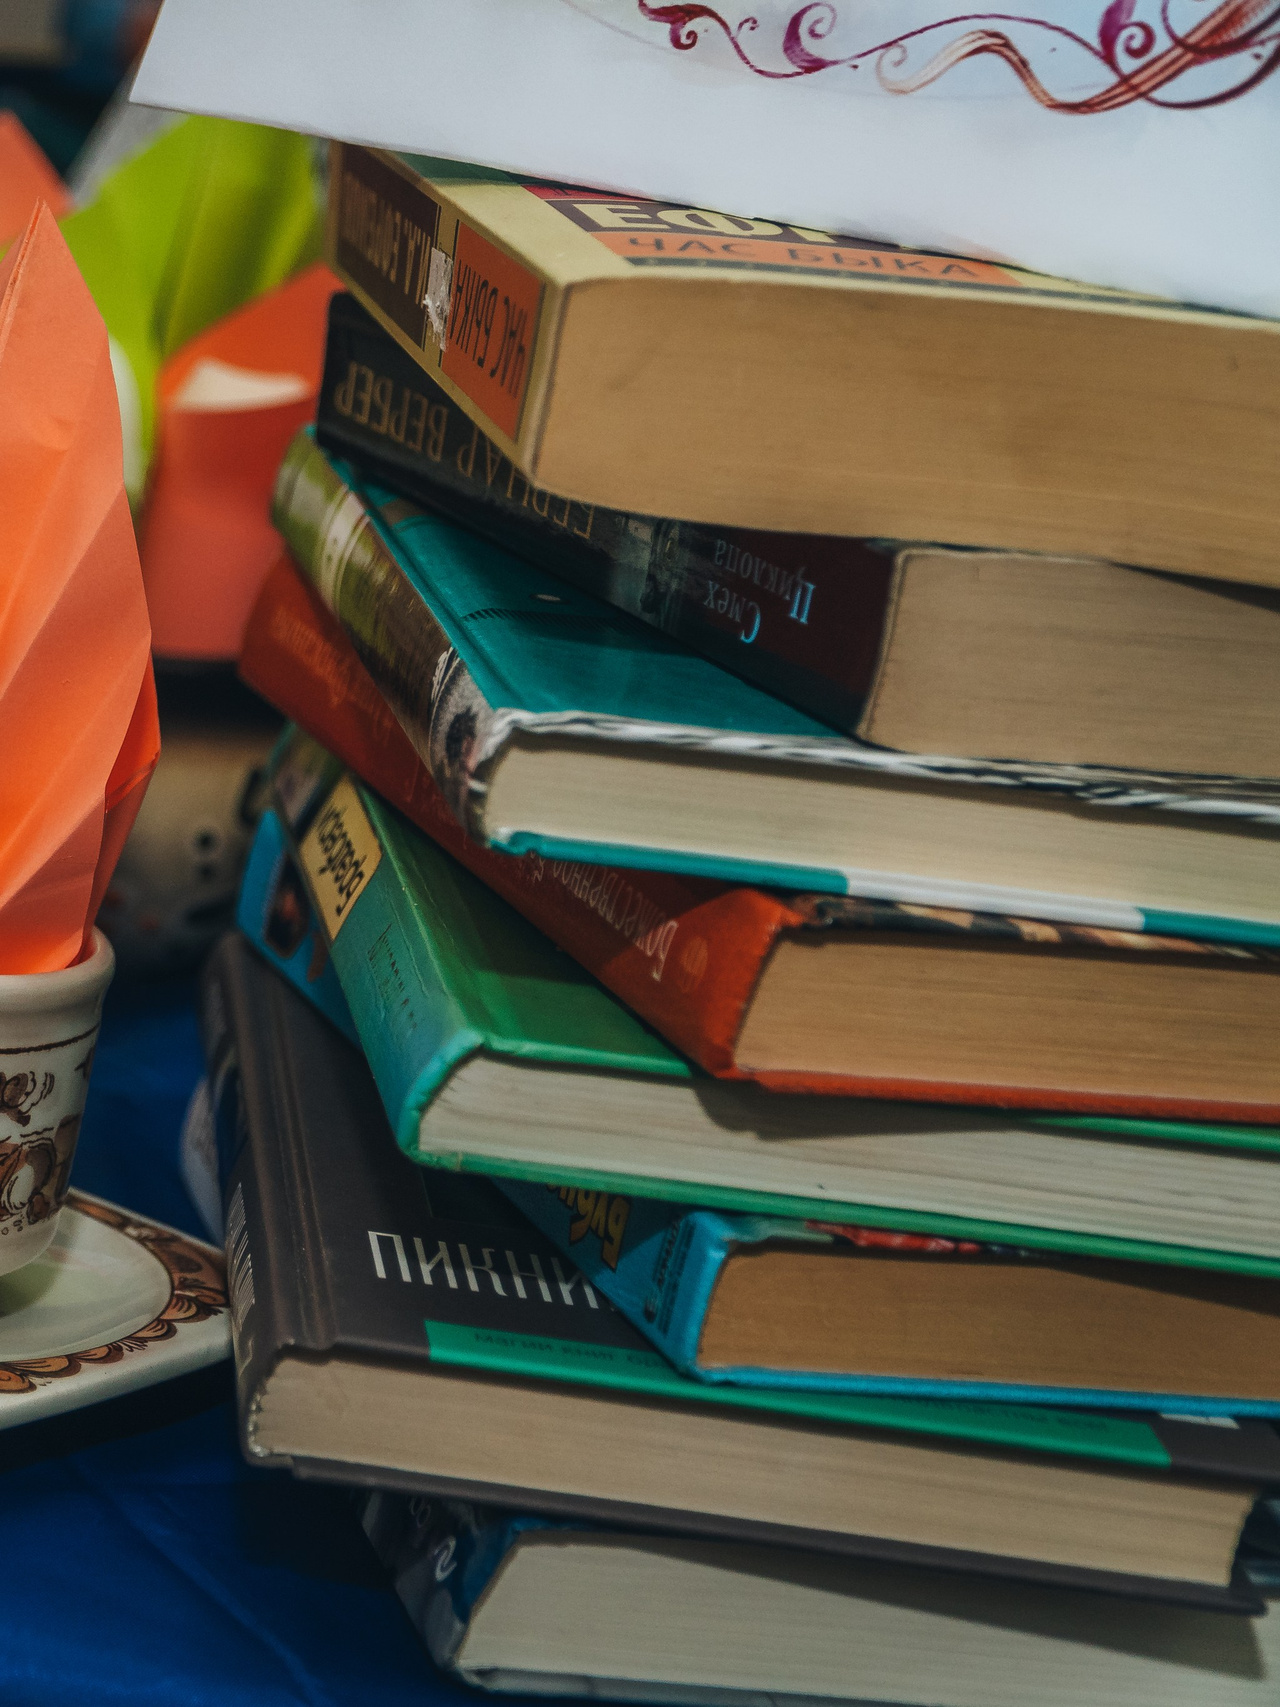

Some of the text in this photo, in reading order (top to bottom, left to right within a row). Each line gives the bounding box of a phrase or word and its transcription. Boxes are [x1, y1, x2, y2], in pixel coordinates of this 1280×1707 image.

[628, 236, 981, 279] ЧАС БЫКА
[449, 260, 499, 367] БЫКА
[333, 360, 448, 463] ВЕРБЕР
[703, 579, 762, 645] Смех
[714, 538, 816, 625] Циклопа
[318, 804, 369, 917] Брэдбери
[367, 1230, 608, 1312] ПИКНИ
